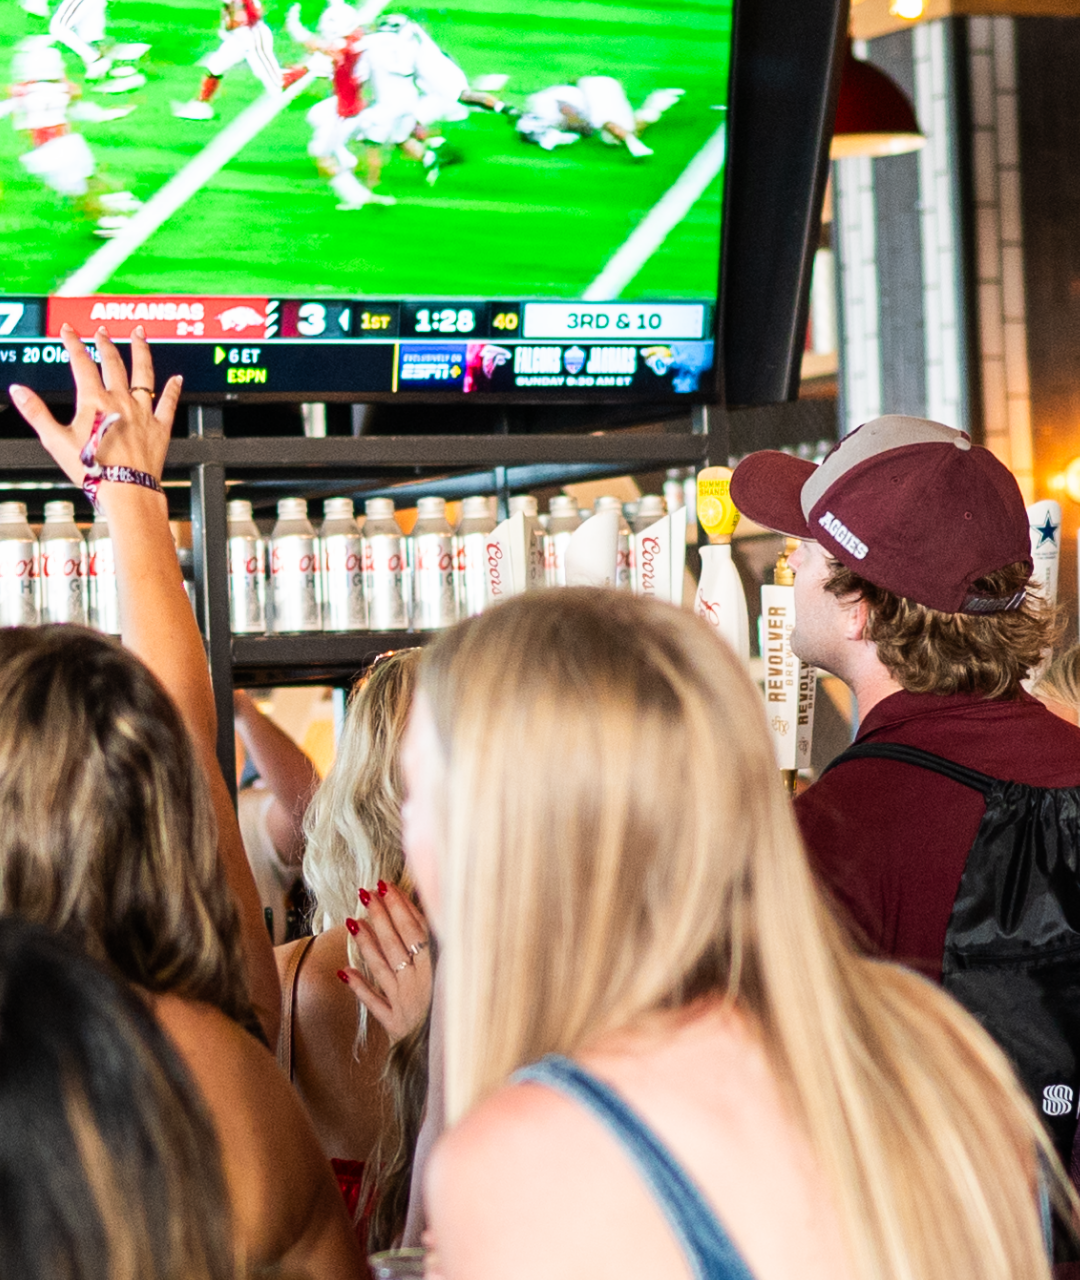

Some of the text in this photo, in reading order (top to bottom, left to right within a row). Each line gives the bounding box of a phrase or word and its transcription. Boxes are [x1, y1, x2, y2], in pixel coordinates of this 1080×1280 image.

[90, 302, 205, 320] ARKANSAS
[296, 302, 326, 336] 3
[415, 308, 475, 332] 1:28
[360, 311, 391, 330] 1ST
[492, 312, 519, 330] 40
[567, 312, 662, 330] 3RD & 10
[22, 347, 41, 363] 20
[227, 347, 261, 363] 6 ET
[227, 367, 267, 384] ESPN
[818, 510, 869, 560] AGGIES
[768, 606, 786, 702] REVOLVER
